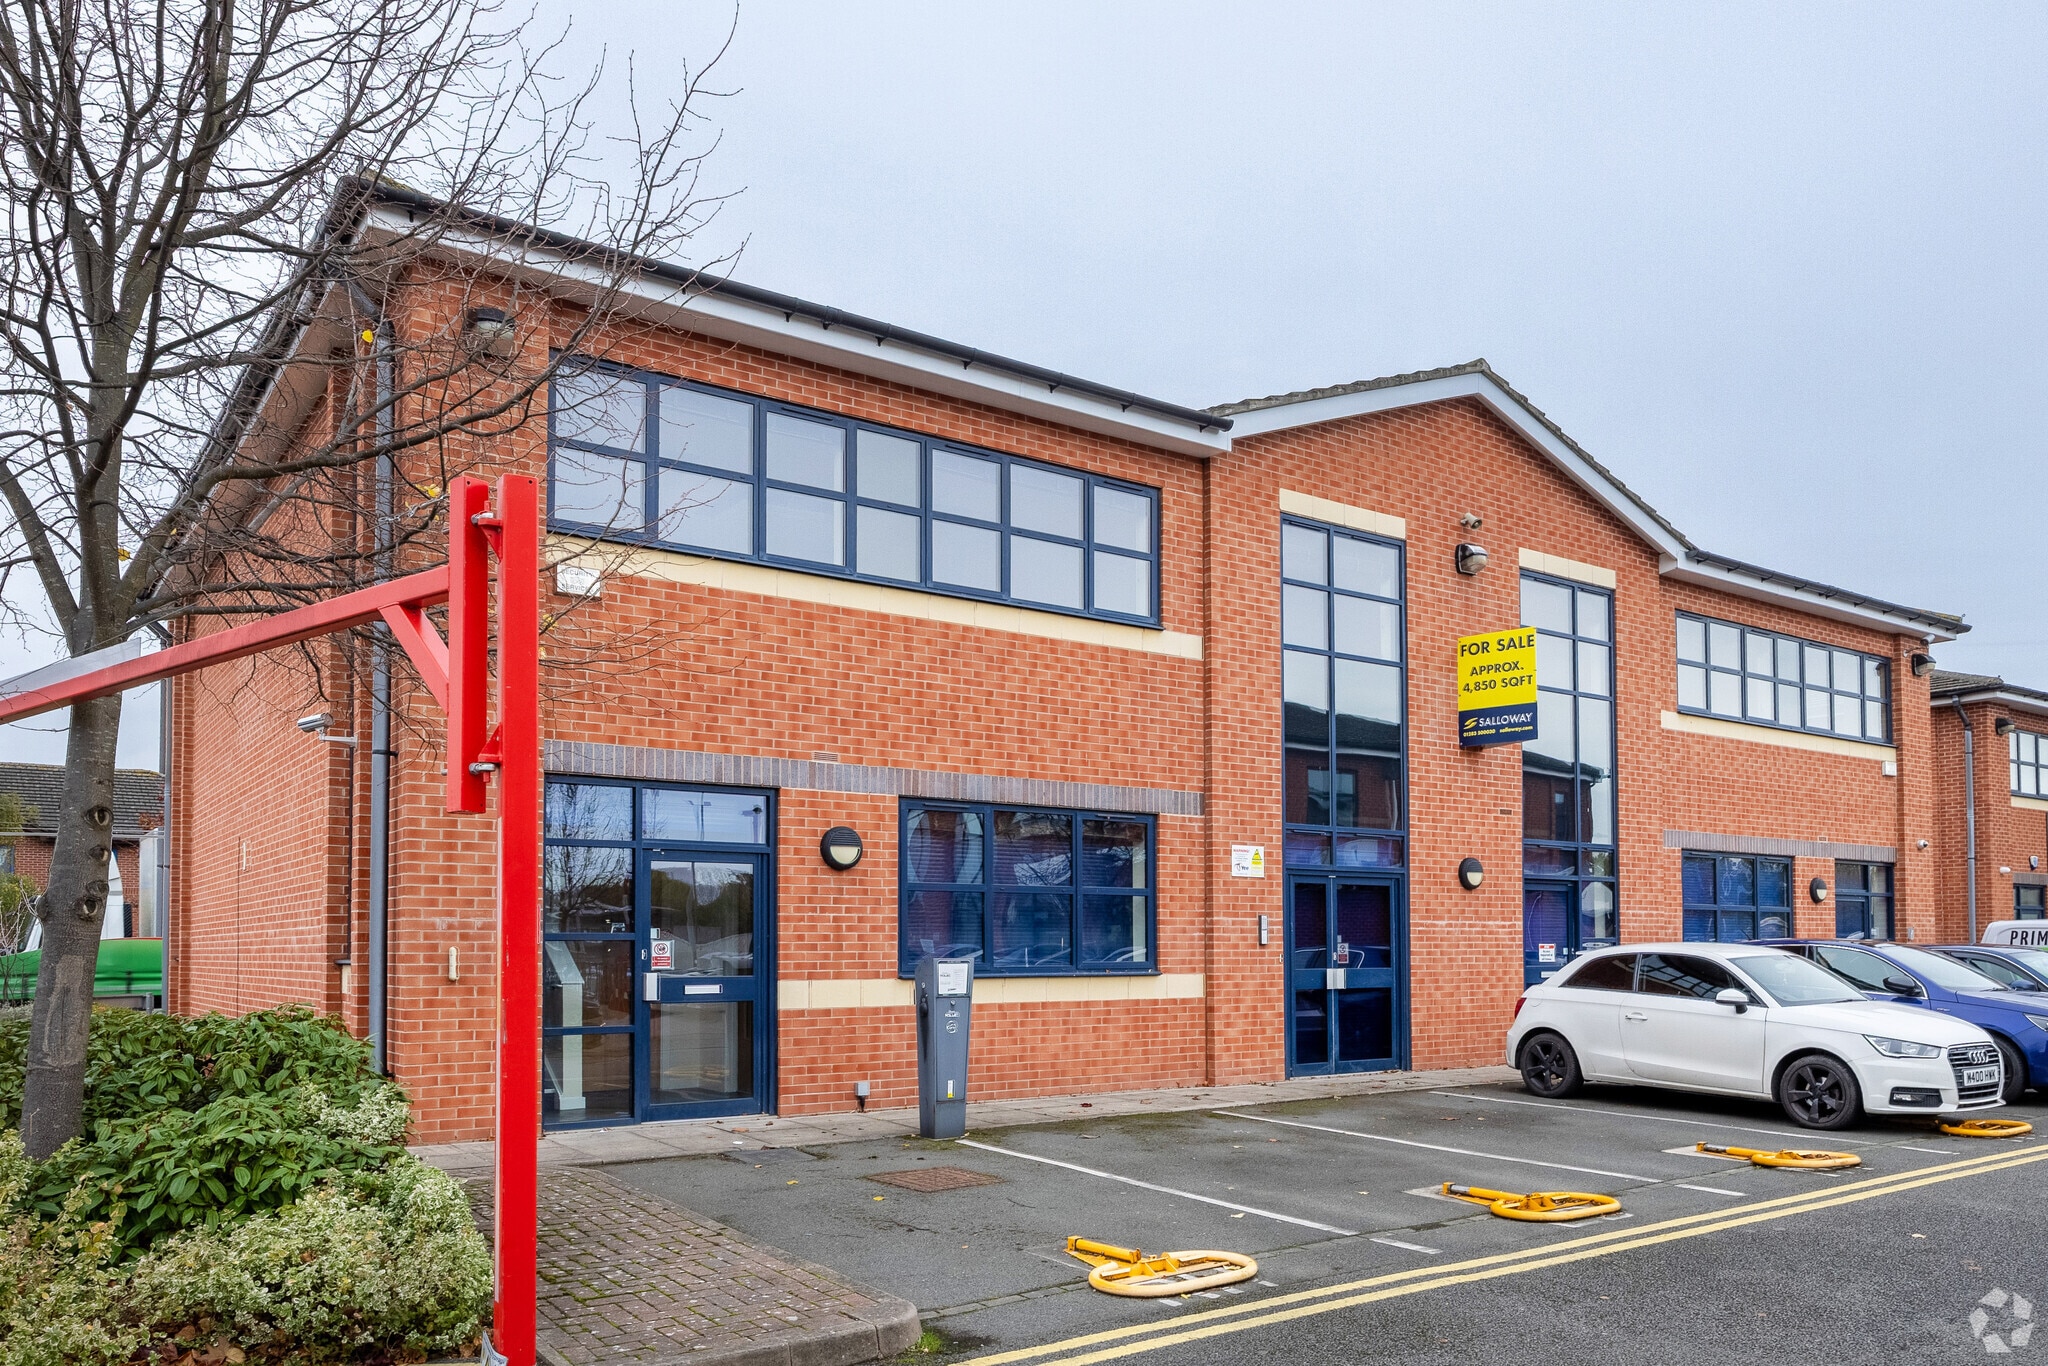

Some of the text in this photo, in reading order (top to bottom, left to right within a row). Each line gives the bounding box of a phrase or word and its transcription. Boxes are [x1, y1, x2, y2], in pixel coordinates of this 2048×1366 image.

[1460, 634, 1535, 657] FOR SALE
[1470, 661, 1524, 676] APPROX.
[1463, 674, 1533, 693] 4,850 SQFT
[1479, 712, 1533, 727] SALLOWAY
[1499, 725, 1533, 733] salloway.com
[2010, 930, 2048, 946] PRIM
